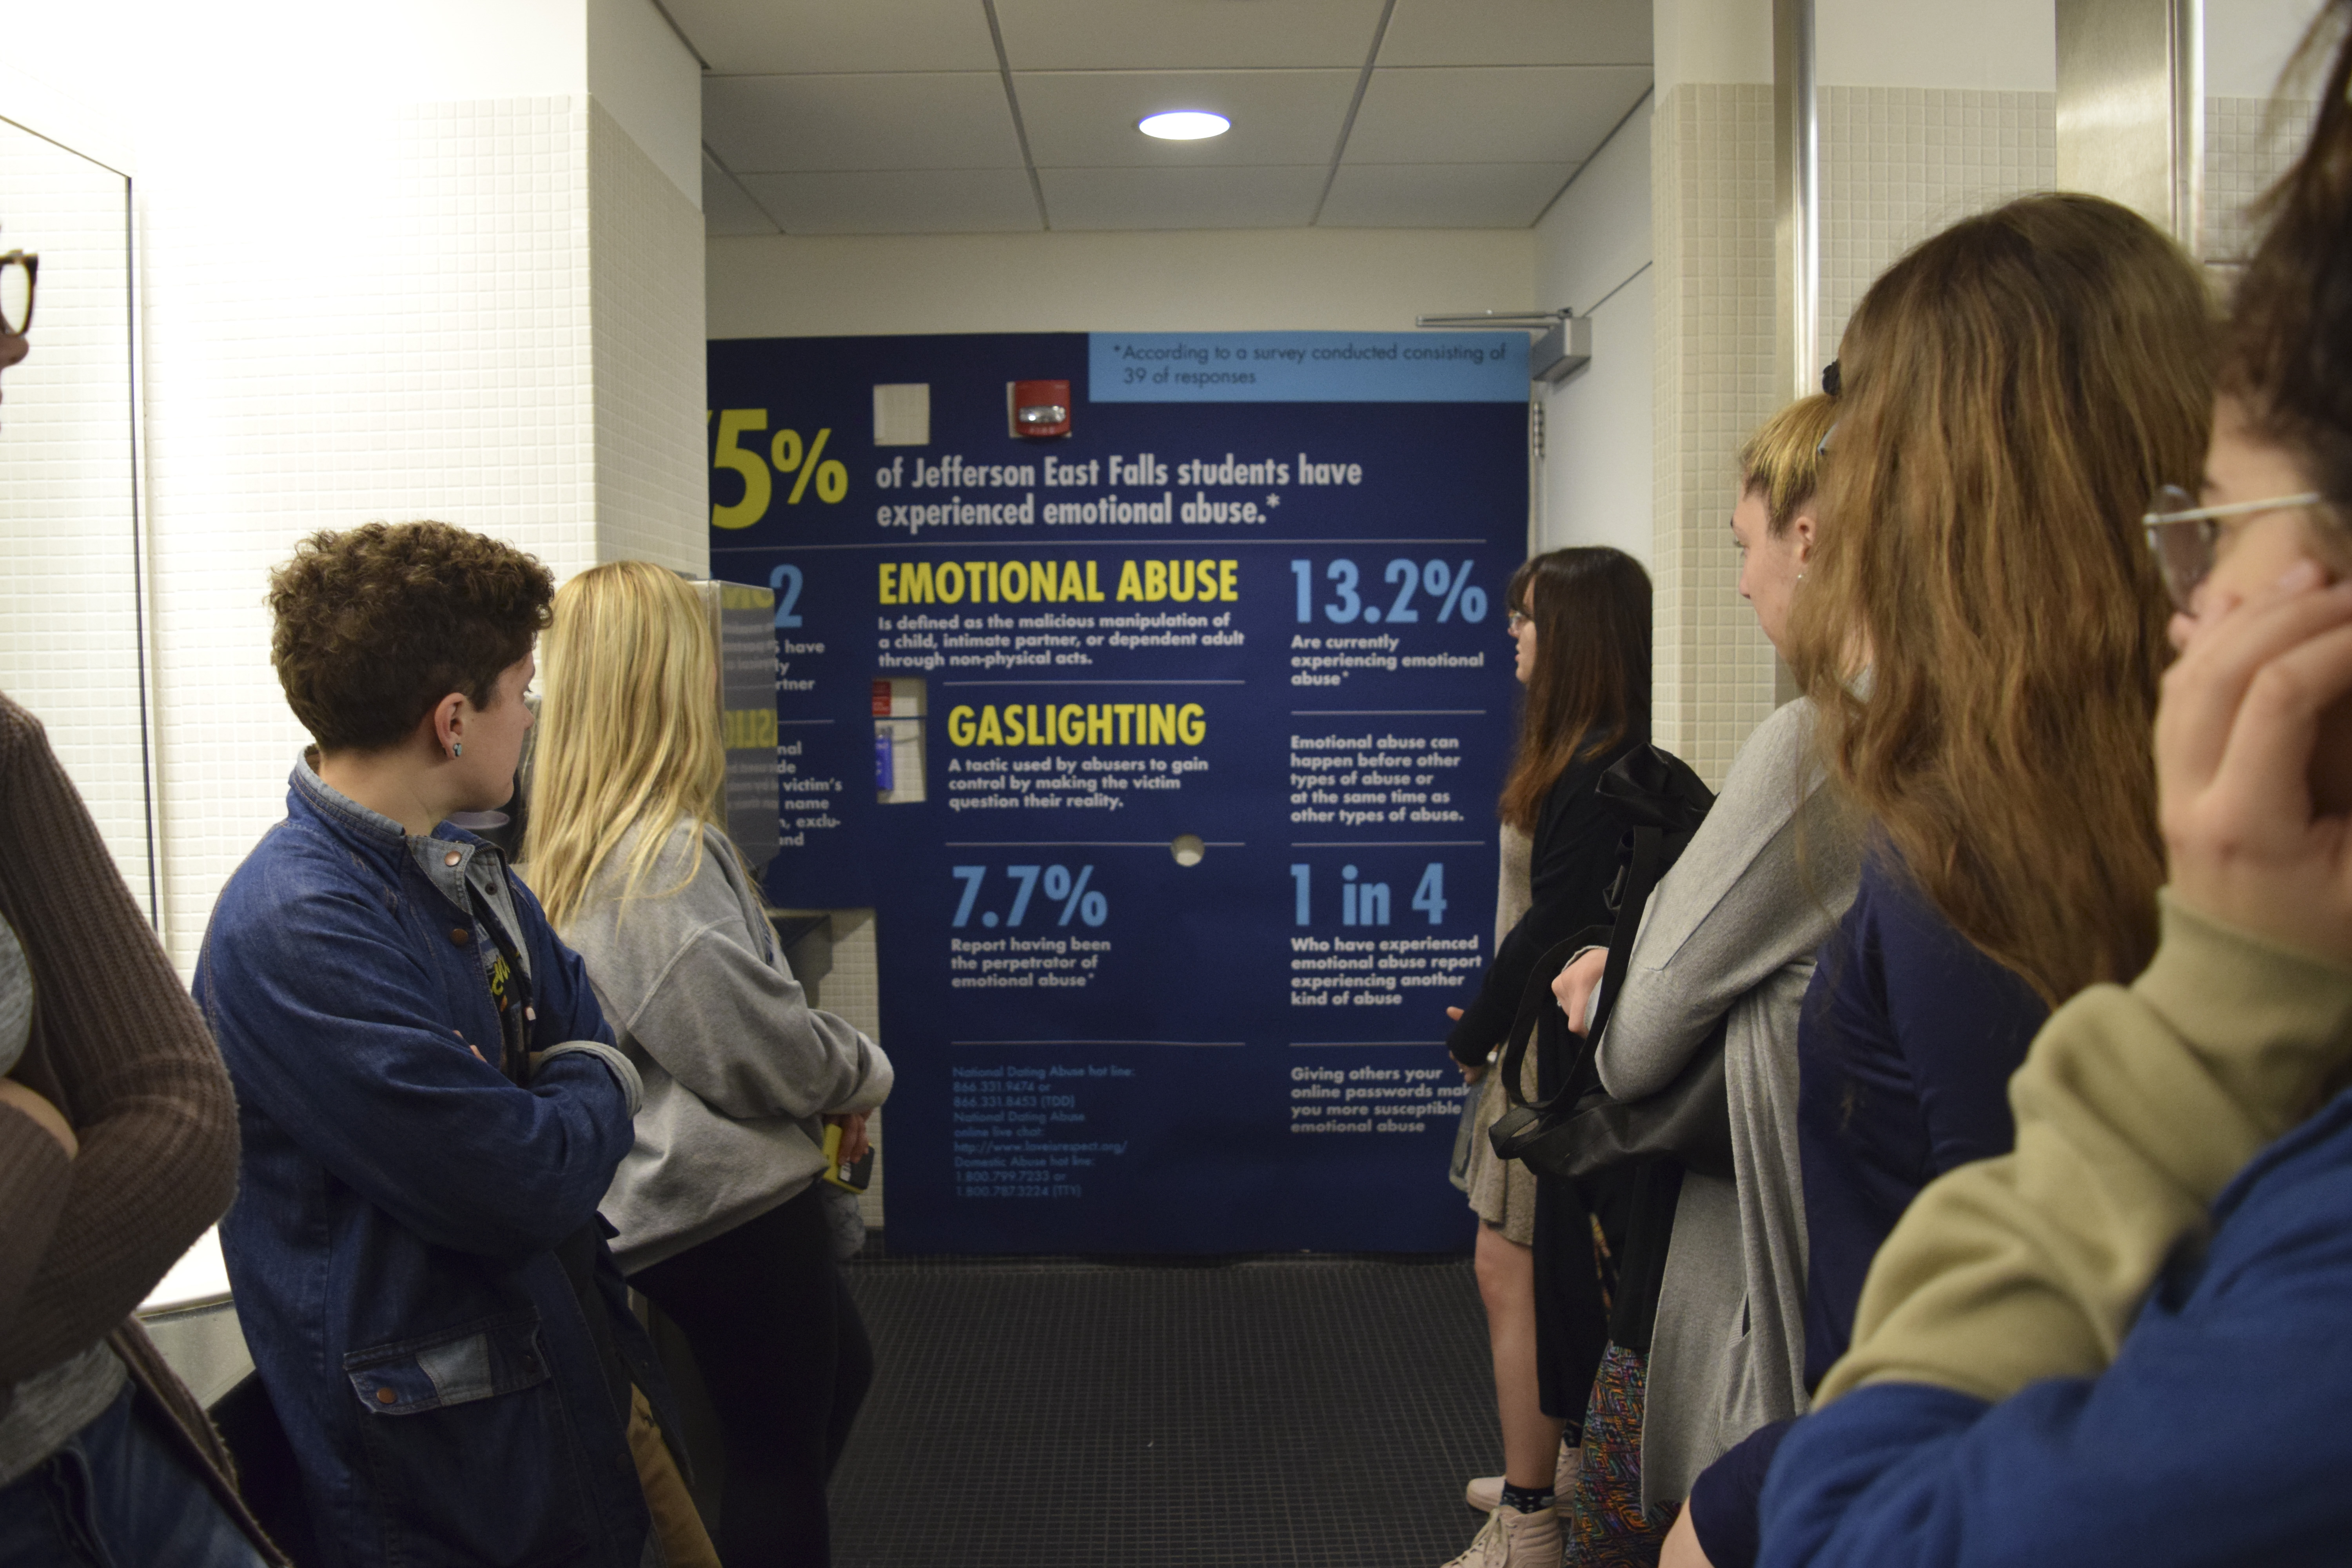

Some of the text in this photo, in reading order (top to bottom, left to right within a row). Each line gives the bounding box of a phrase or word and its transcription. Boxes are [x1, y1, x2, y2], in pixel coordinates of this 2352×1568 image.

[1214, 347, 1230, 360] to
[1236, 348, 1247, 360] a
[1253, 348, 1306, 364] survey
[1312, 342, 1398, 360] conducted
[1403, 344, 1485, 365] consisting
[1490, 343, 1506, 360] of
[1123, 365, 1256, 388] 39 of responses
[707, 408, 848, 529] 5%
[877, 453, 1361, 488] of Jefferson East Falls students have
[878, 493, 1034, 534] experienced
[1043, 492, 1172, 524] emotional
[880, 560, 1237, 603] EMOTIONAL ABUSE
[1291, 559, 1486, 623] 13.2%
[878, 612, 1230, 632] Is defined as the malicious manipulation of
[785, 639, 825, 653] have
[879, 631, 1244, 651] a child, intimate partner, or dependent adult
[1291, 634, 1399, 652] Are currently
[879, 650, 1093, 670] through non-physical acts.
[1291, 653, 1483, 671] experiencing emotional
[775, 677, 815, 691] rtner
[949, 704, 1205, 746] GASLIGHTING
[1291, 734, 1459, 749] Emotional abuse can
[949, 756, 1209, 775] A tactic used by abusers to gain
[1290, 752, 1460, 770] happen before other
[949, 775, 1181, 792] control by making the victim
[1290, 771, 1433, 789] types of abuse or
[785, 800, 829, 809] name
[949, 793, 1123, 811] question their reality.
[1291, 789, 1450, 804] at the same time as
[1291, 807, 1463, 825] other types of abuse.
[779, 831, 804, 846] nd
[953, 864, 1107, 927] 7.7%
[1291, 863, 1446, 925] 1 in 4
[951, 936, 1111, 955] Report having been
[1291, 935, 1478, 953] Who have experienced
[951, 955, 1098, 972] the perpetrator of
[1291, 955, 1482, 971] emotional abuse report
[952, 972, 1033, 987] emotional
[1292, 972, 1464, 991] experiencing another
[1291, 991, 1402, 1005] kind of abuse
[1291, 1066, 1442, 1083] Giving others your
[1291, 1082, 1471, 1100] online passwords mak
[1291, 1100, 1461, 1118] you more susceptible
[1291, 1119, 1425, 1132] emotional abuse
